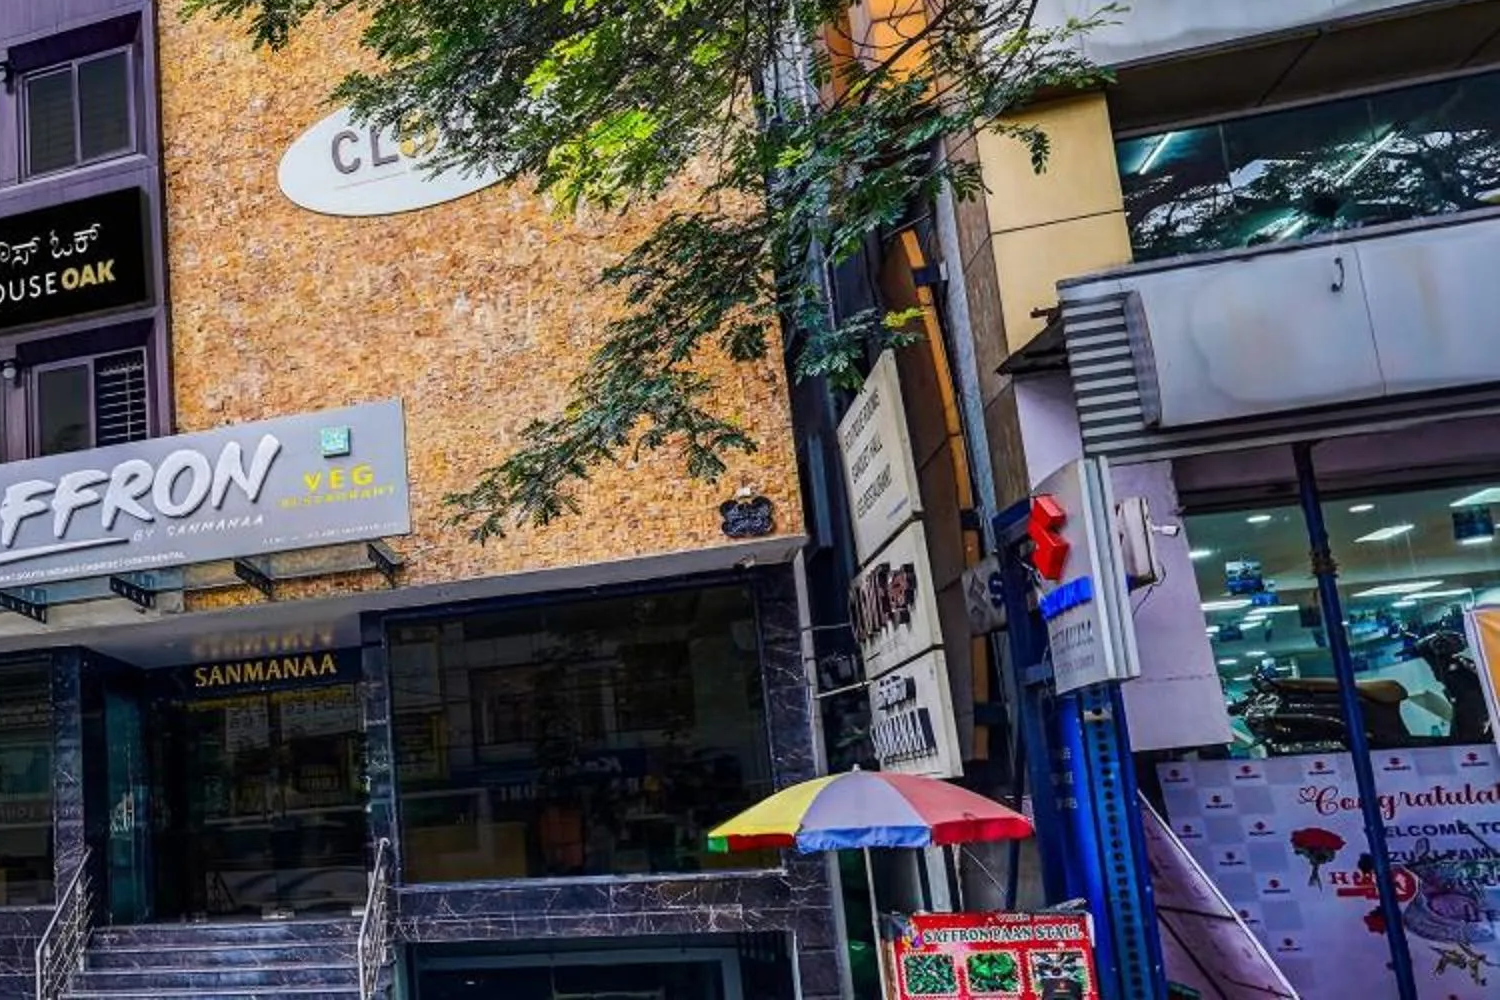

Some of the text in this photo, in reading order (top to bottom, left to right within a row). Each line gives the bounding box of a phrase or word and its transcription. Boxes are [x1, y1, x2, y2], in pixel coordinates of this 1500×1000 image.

[61, 258, 116, 290] OAK
[304, 462, 374, 493] VEG
[166, 514, 264, 538] SANMANAA
[194, 653, 338, 688] SANMANAA
[1384, 822, 1470, 838] ELCOME
[923, 928, 990, 943] SAFFRON
[1036, 923, 1081, 940] STALL
